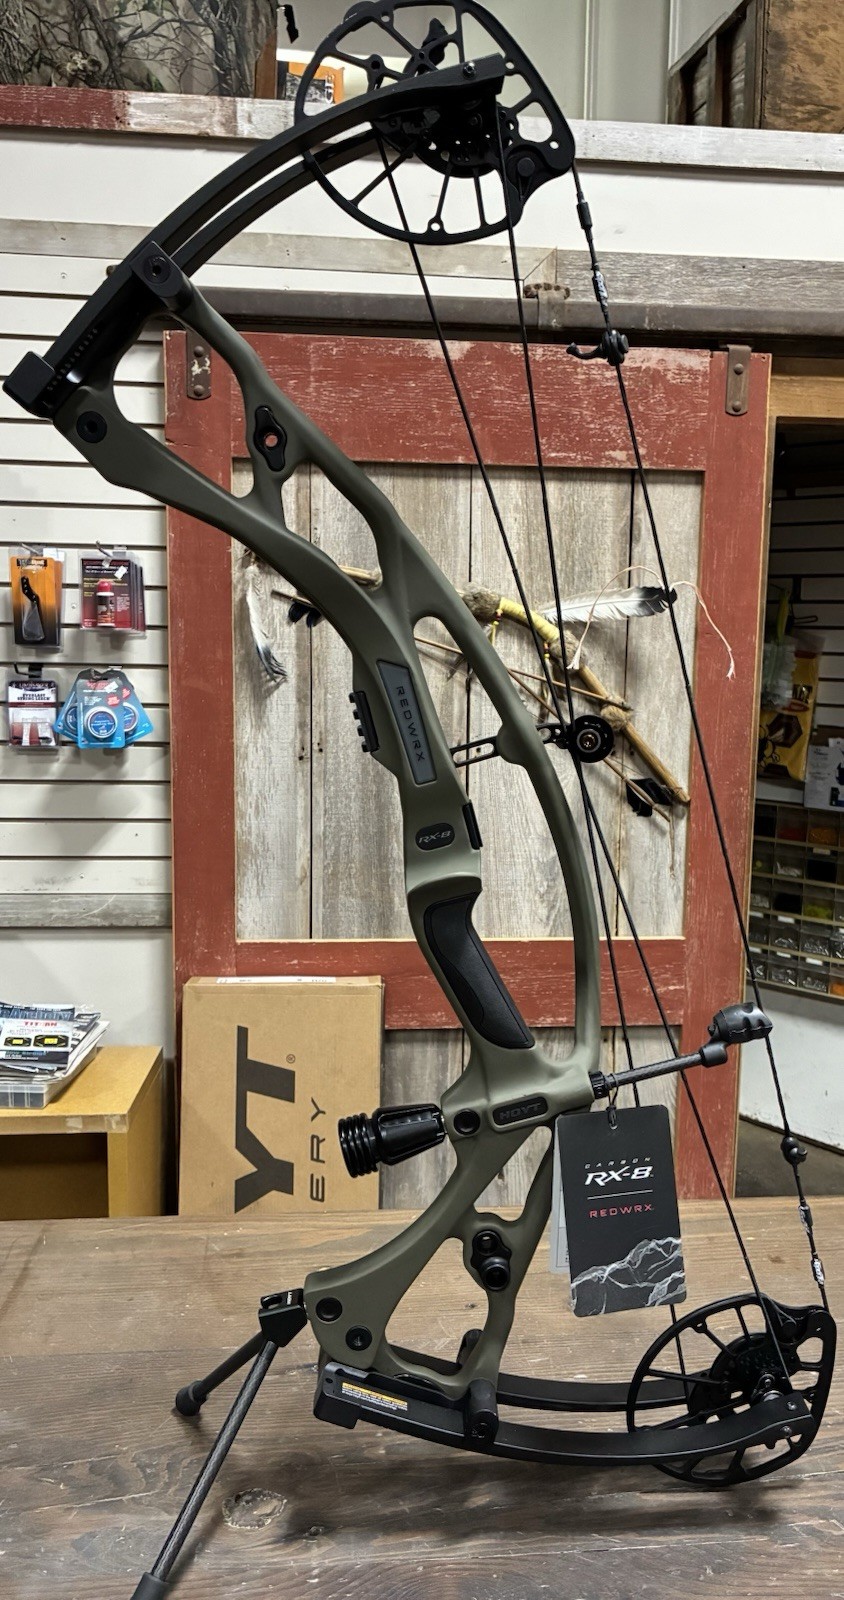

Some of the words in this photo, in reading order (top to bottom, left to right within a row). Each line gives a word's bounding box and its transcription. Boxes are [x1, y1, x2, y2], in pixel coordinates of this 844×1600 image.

[396, 685, 426, 762] REDWRX
[418, 830, 451, 845] RX-8
[498, 1103, 542, 1121] HOYT
[310, 1097, 326, 1202] ERY
[585, 1157, 651, 1169] CARBON
[584, 1165, 653, 1187] RX-8
[588, 1203, 653, 1219] REDWRX
